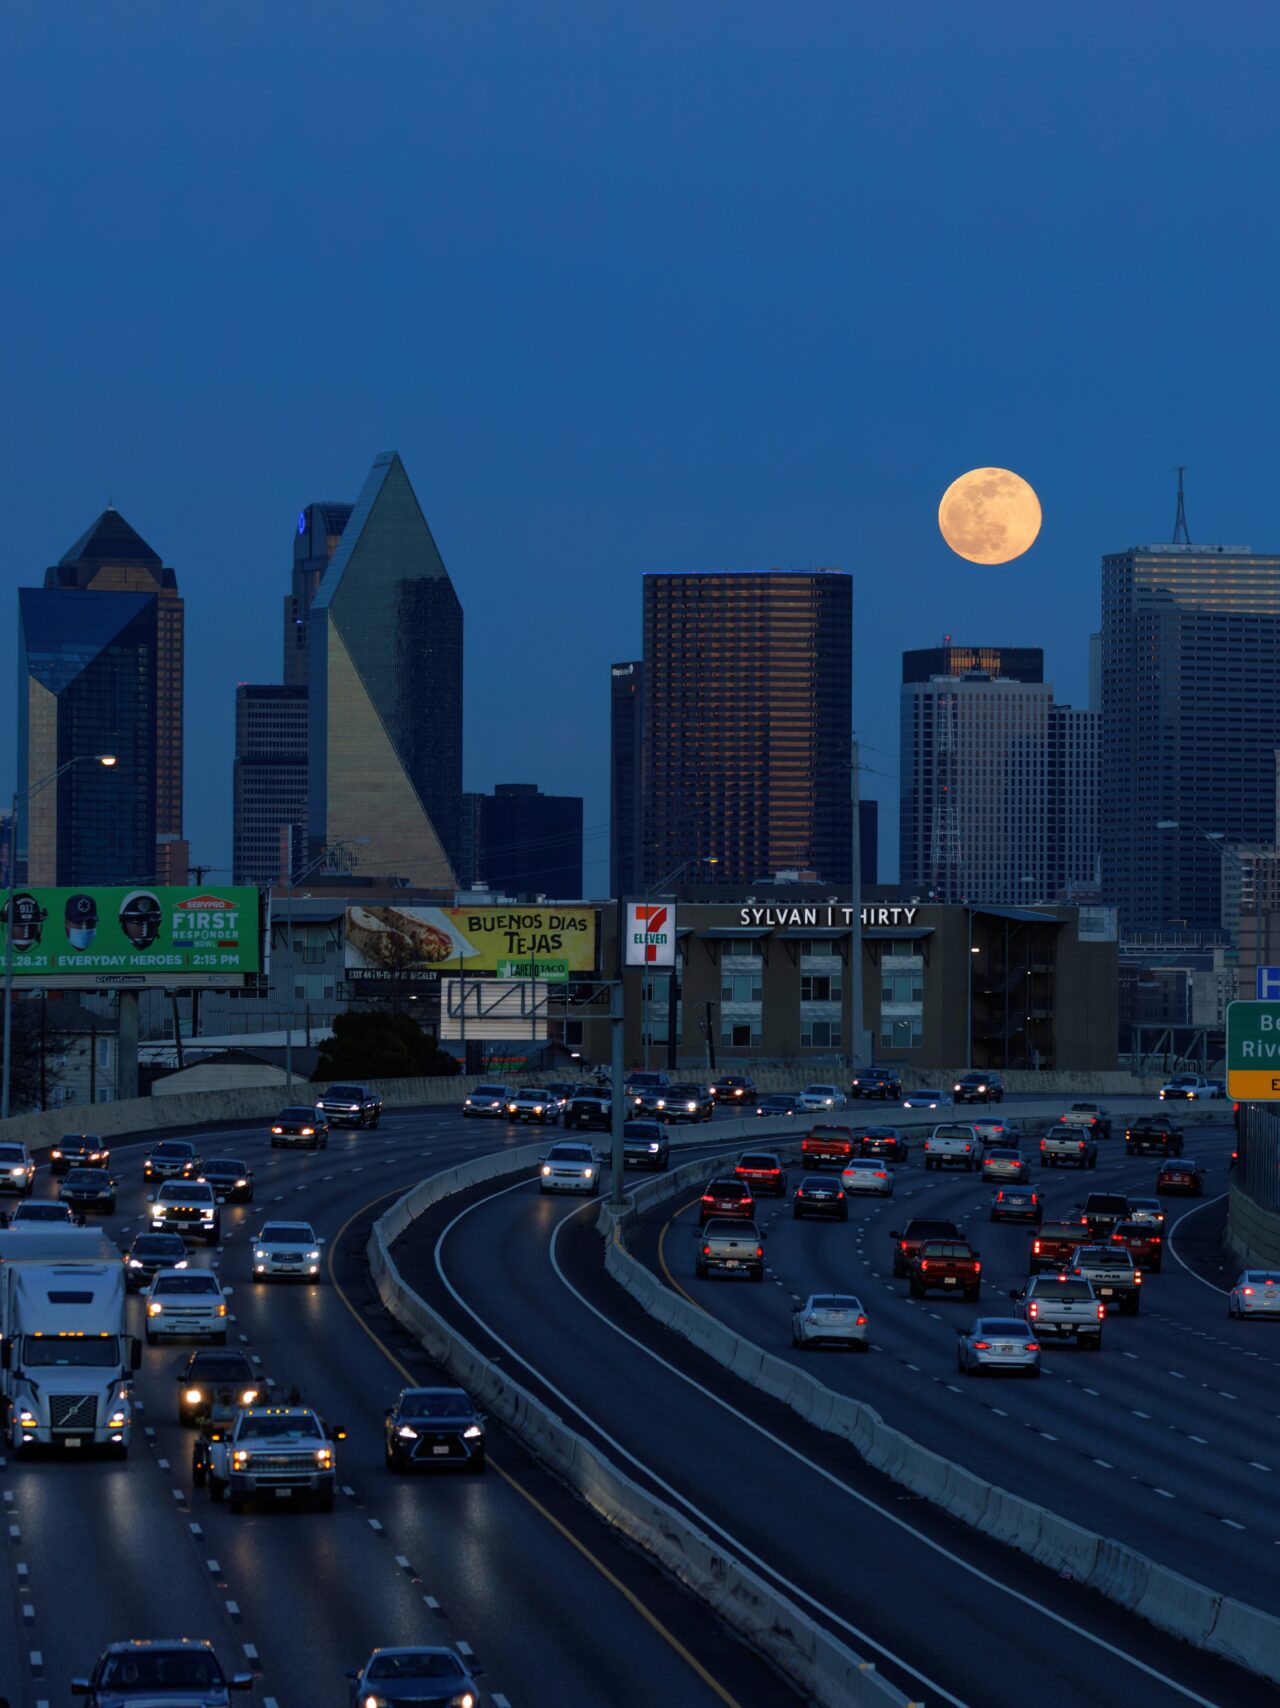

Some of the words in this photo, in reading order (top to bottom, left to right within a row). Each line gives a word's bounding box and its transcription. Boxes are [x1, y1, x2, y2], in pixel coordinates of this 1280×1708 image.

[187, 901, 225, 909] SERVPRO
[172, 912, 239, 929] F1RST
[468, 914, 543, 932] BUENOS
[549, 916, 588, 931] DIAS
[740, 908, 817, 925] SYLVAN
[172, 930, 239, 939] RESPONDER
[504, 931, 563, 954] TEJAS
[0, 956, 47, 966] 1.28.21
[58, 955, 125, 966] EVERYDAY
[130, 955, 182, 965] HEROES
[193, 955, 217, 965] 2:15
[220, 955, 239, 965] PM
[541, 965, 565, 973] TACO
